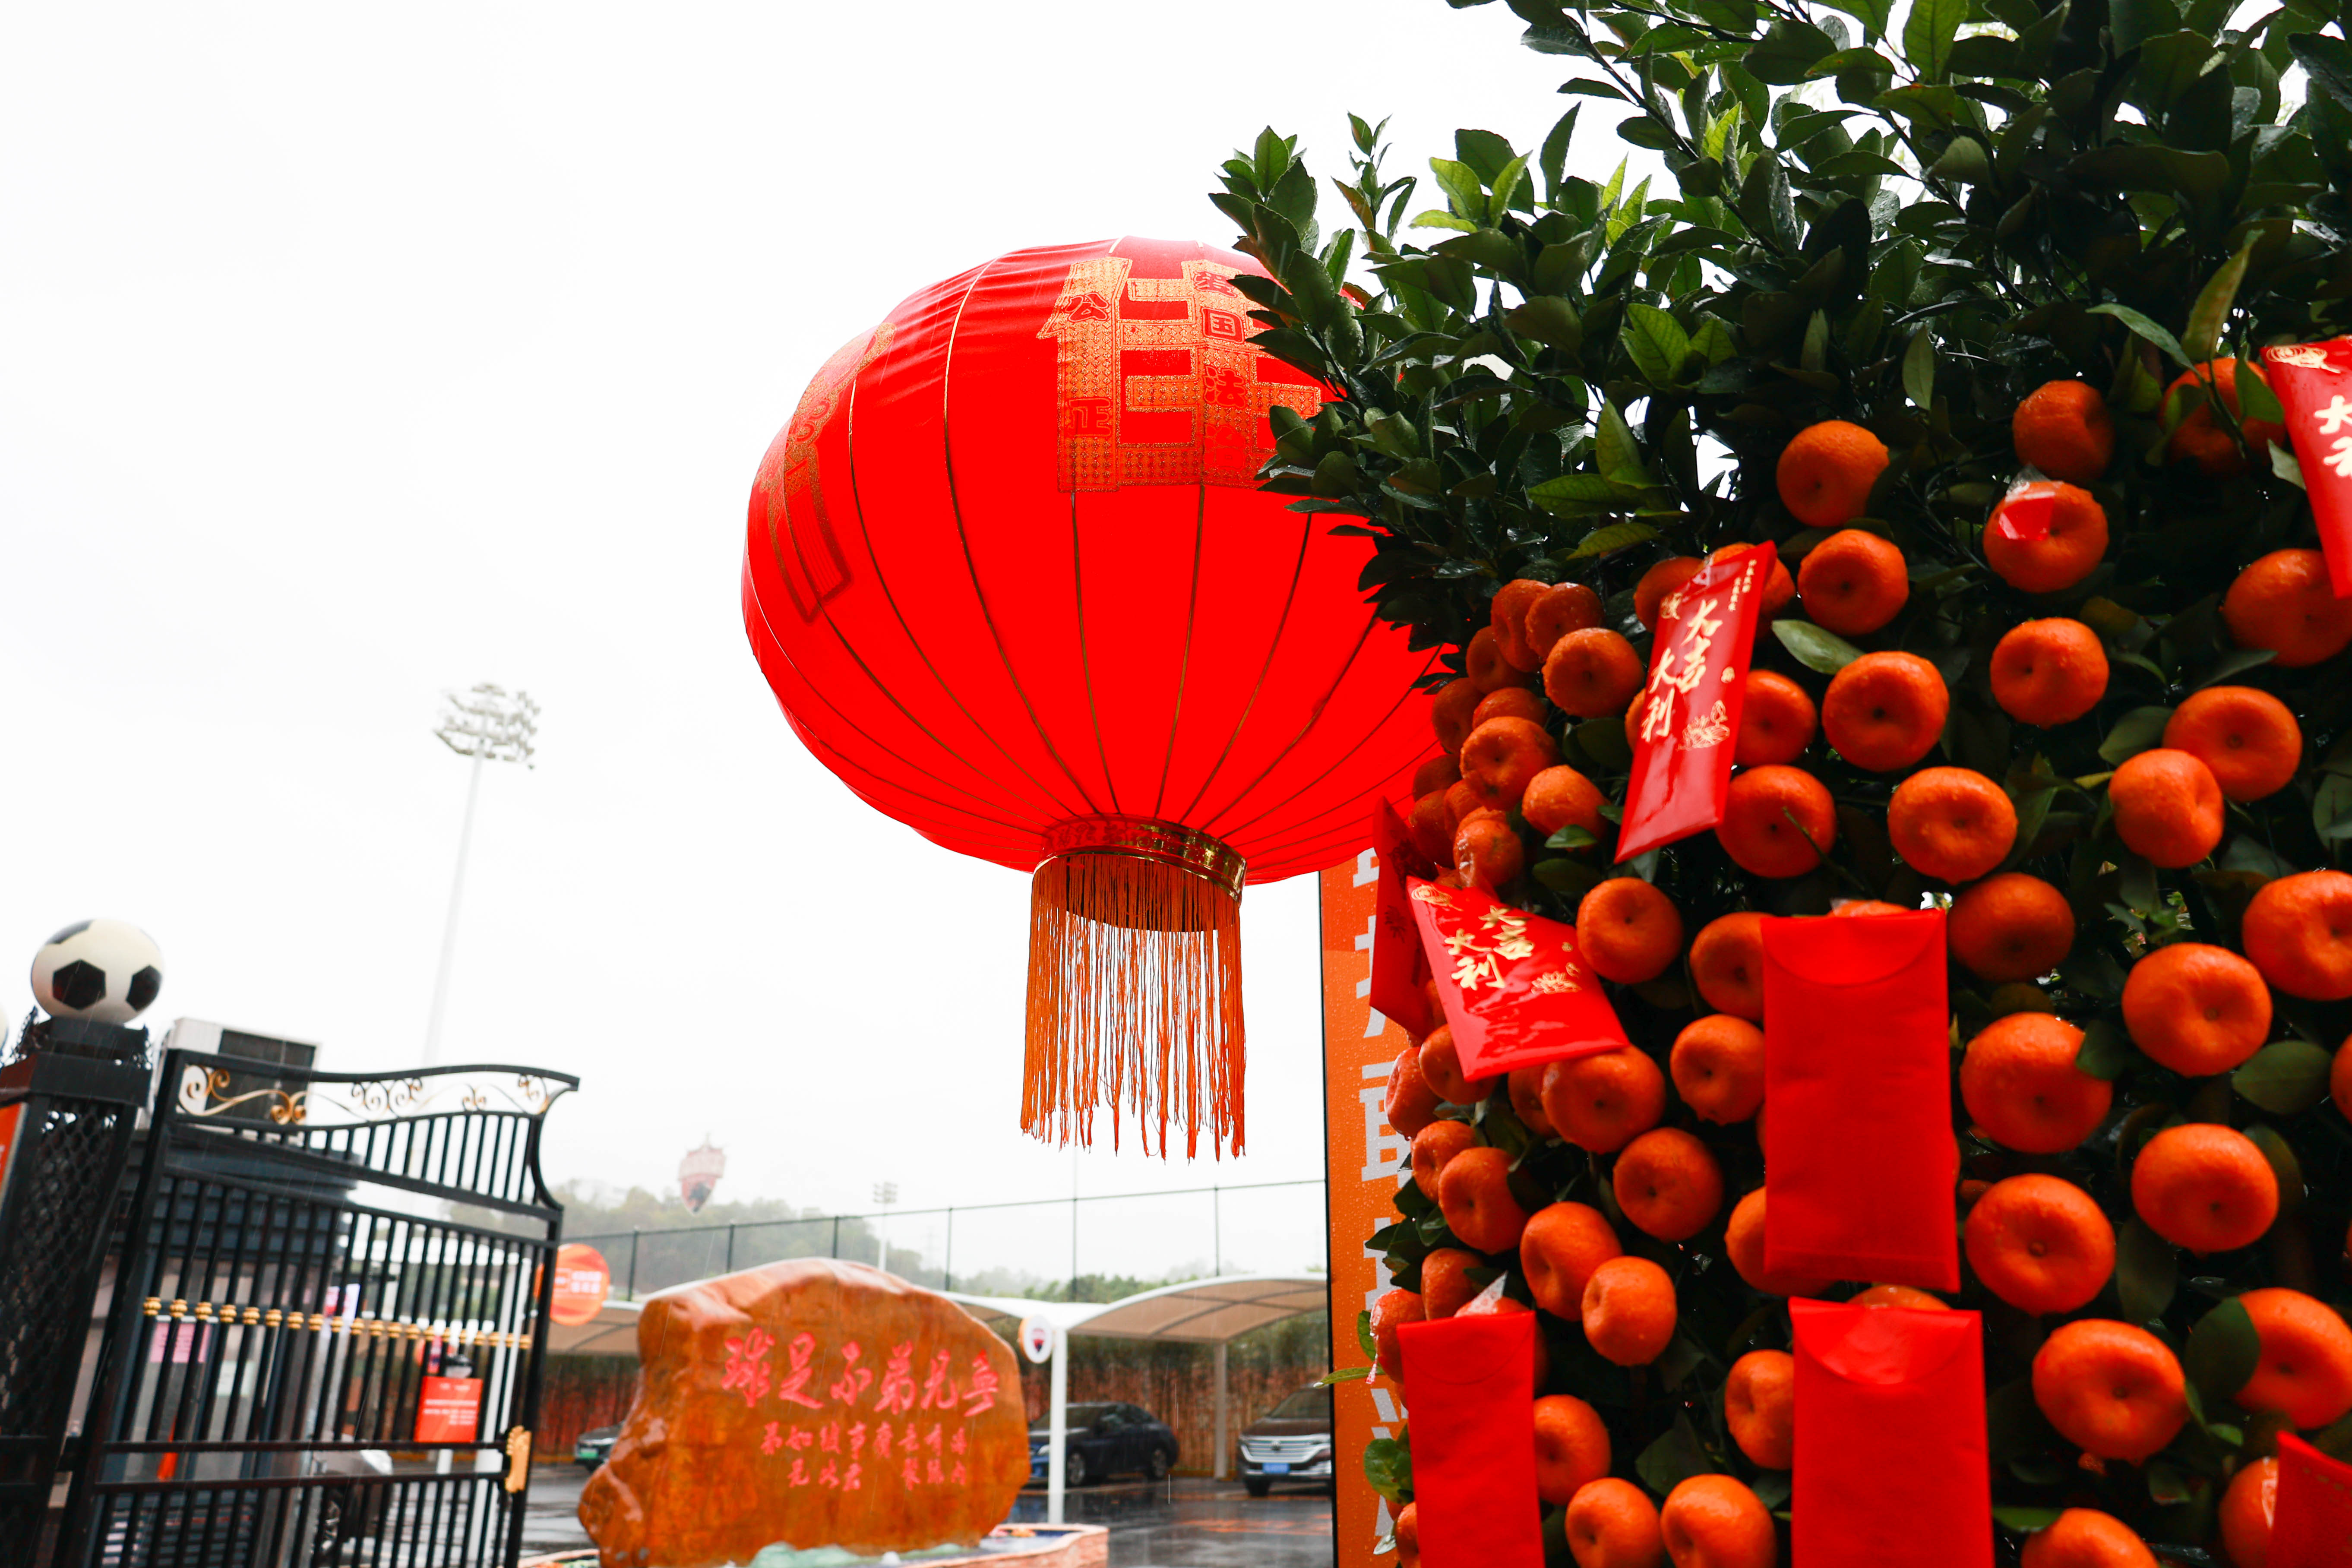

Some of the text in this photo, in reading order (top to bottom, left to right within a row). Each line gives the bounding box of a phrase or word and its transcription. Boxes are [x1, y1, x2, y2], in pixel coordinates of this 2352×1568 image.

[1676, 598, 1723, 694] 大吉
[1642, 648, 1676, 743] 大利
[1445, 929, 1505, 990] 大利
[1479, 906, 1534, 960] 大吉
